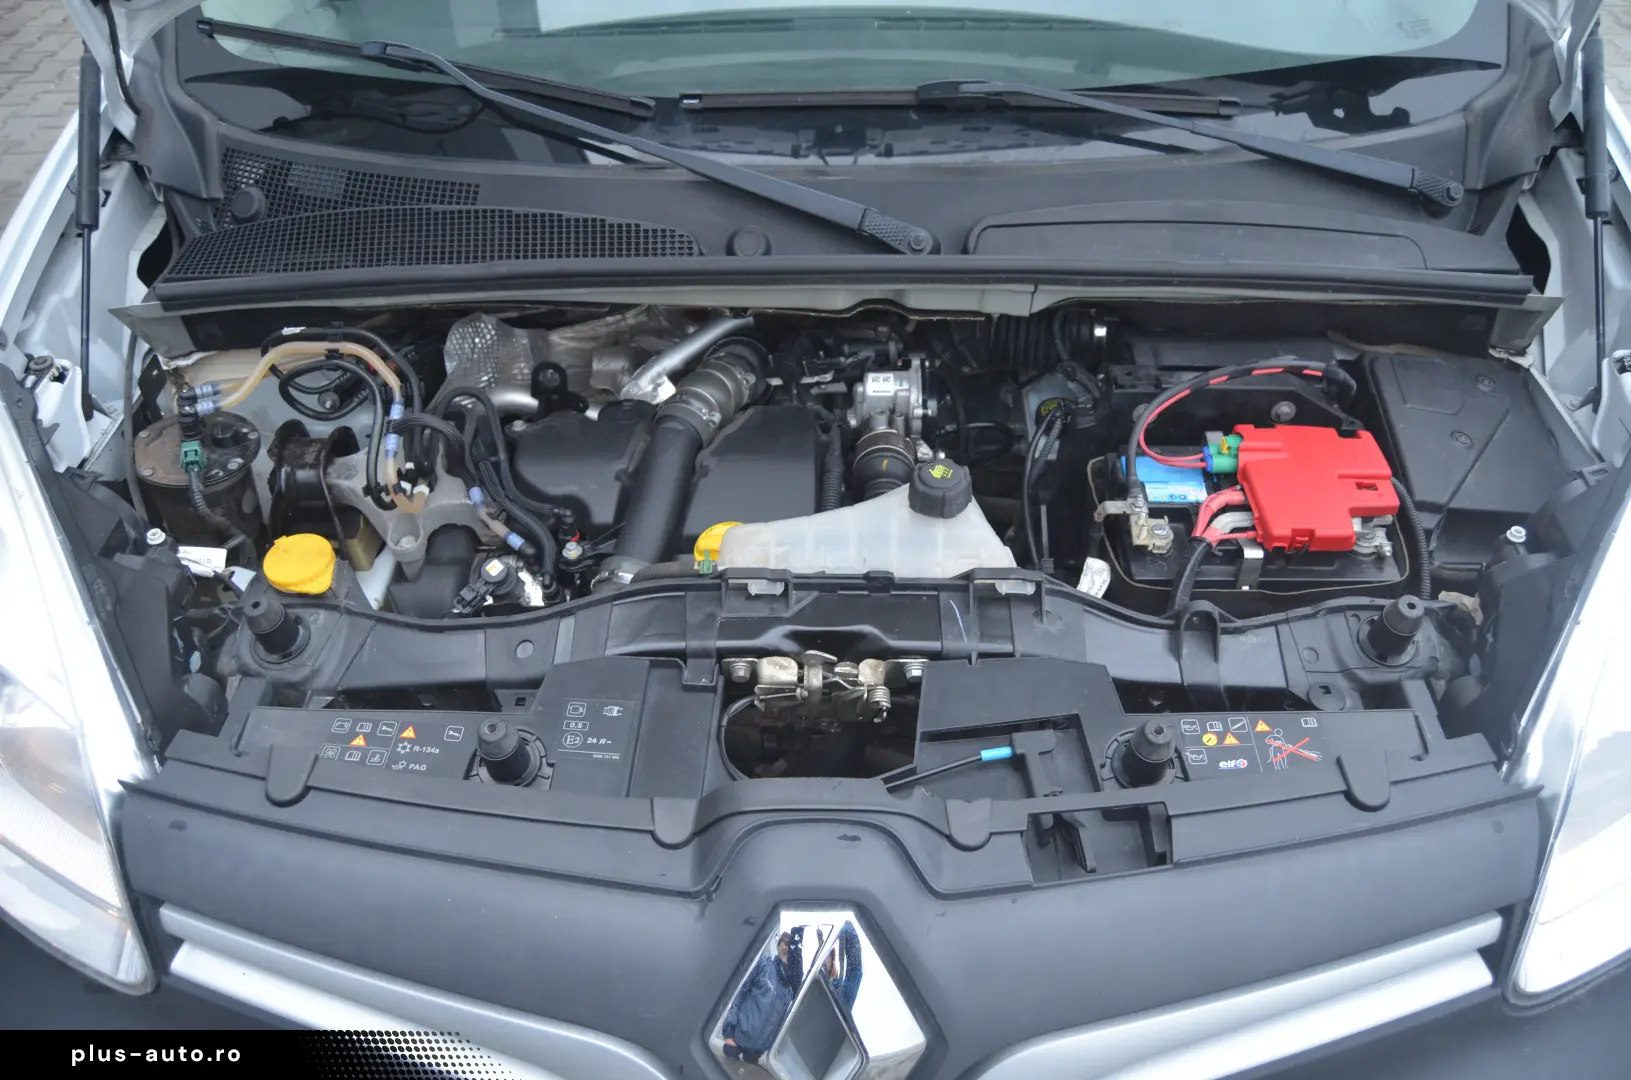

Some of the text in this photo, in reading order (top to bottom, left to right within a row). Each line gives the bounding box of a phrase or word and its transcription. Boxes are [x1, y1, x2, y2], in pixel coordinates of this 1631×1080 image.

[566, 735, 581, 745] E2
[413, 745, 440, 754] R-134a
[408, 763, 427, 771] PAG
[1218, 760, 1237, 768] elf
